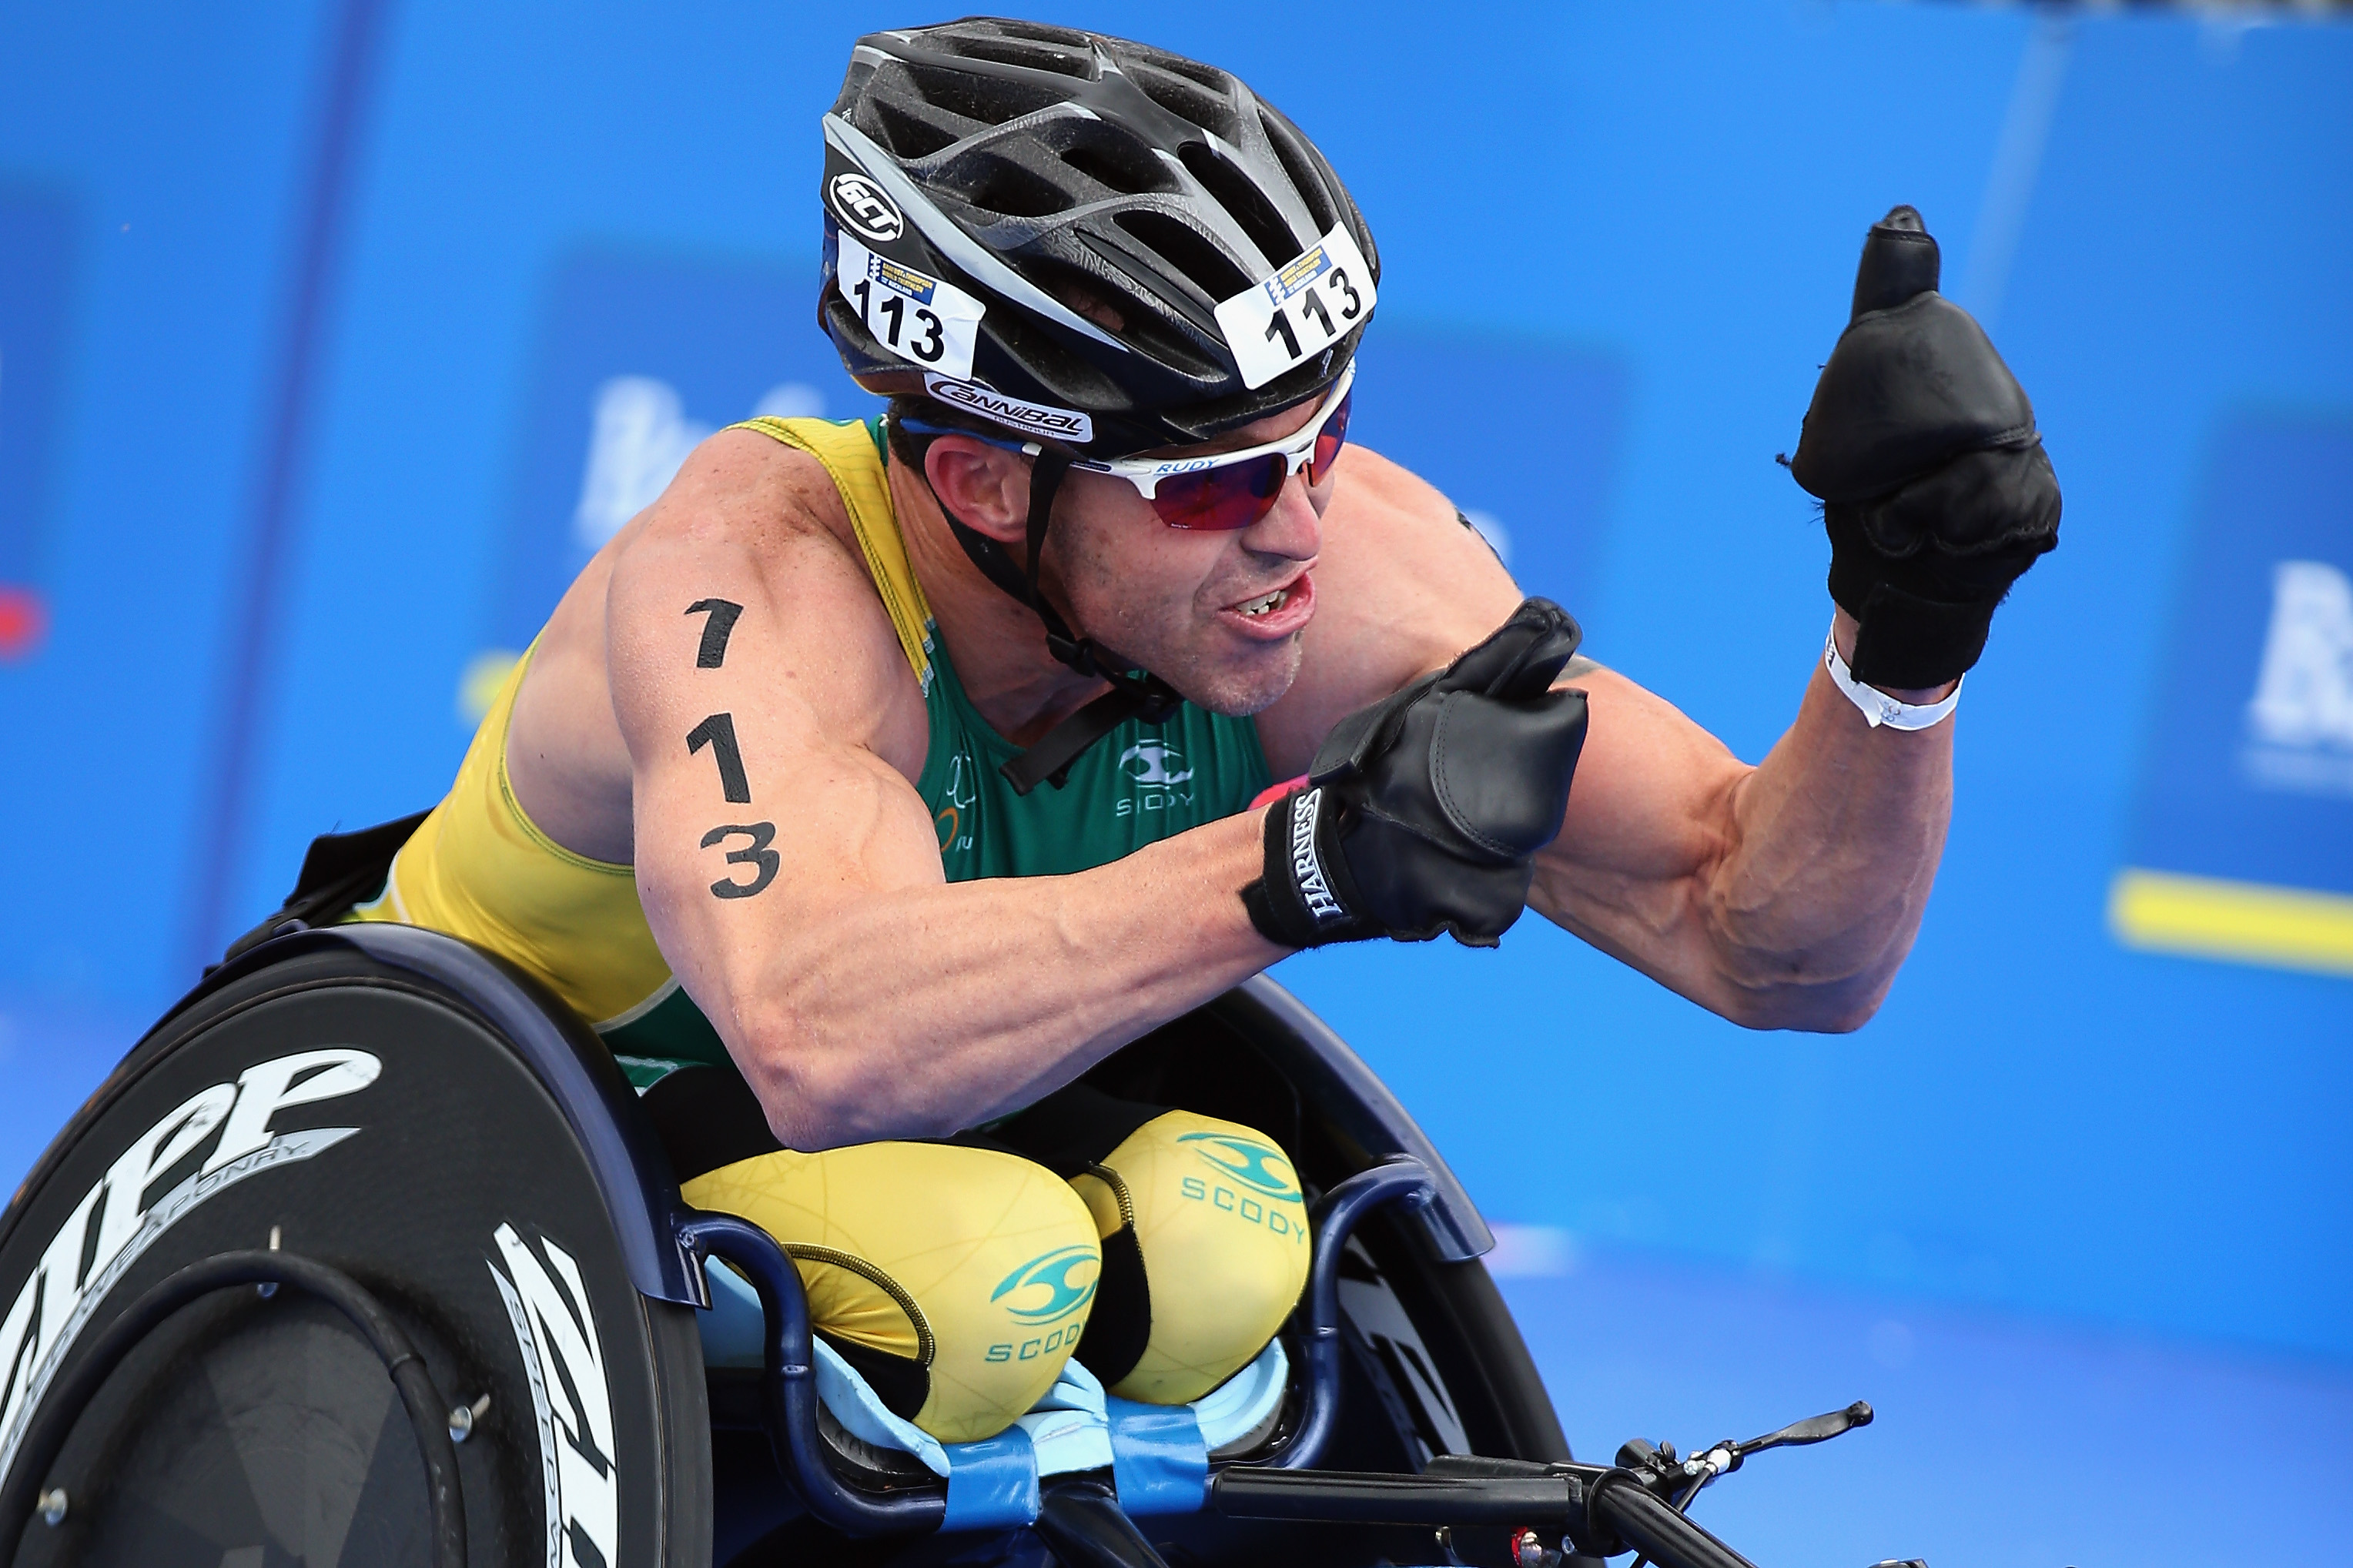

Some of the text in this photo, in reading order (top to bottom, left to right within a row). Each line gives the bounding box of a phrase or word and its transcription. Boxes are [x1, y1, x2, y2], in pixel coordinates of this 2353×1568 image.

[836, 180, 899, 230] GCT
[854, 278, 946, 363] 113
[1264, 266, 1361, 360] 113
[1156, 458, 1220, 473] RUDY
[1116, 792, 1195, 816] SOY
[1293, 787, 1343, 918] HARNESS
[1181, 1175, 1307, 1245] SCODY
[985, 1316, 1088, 1362] SCOD
[508, 1298, 556, 1497] SPEED
